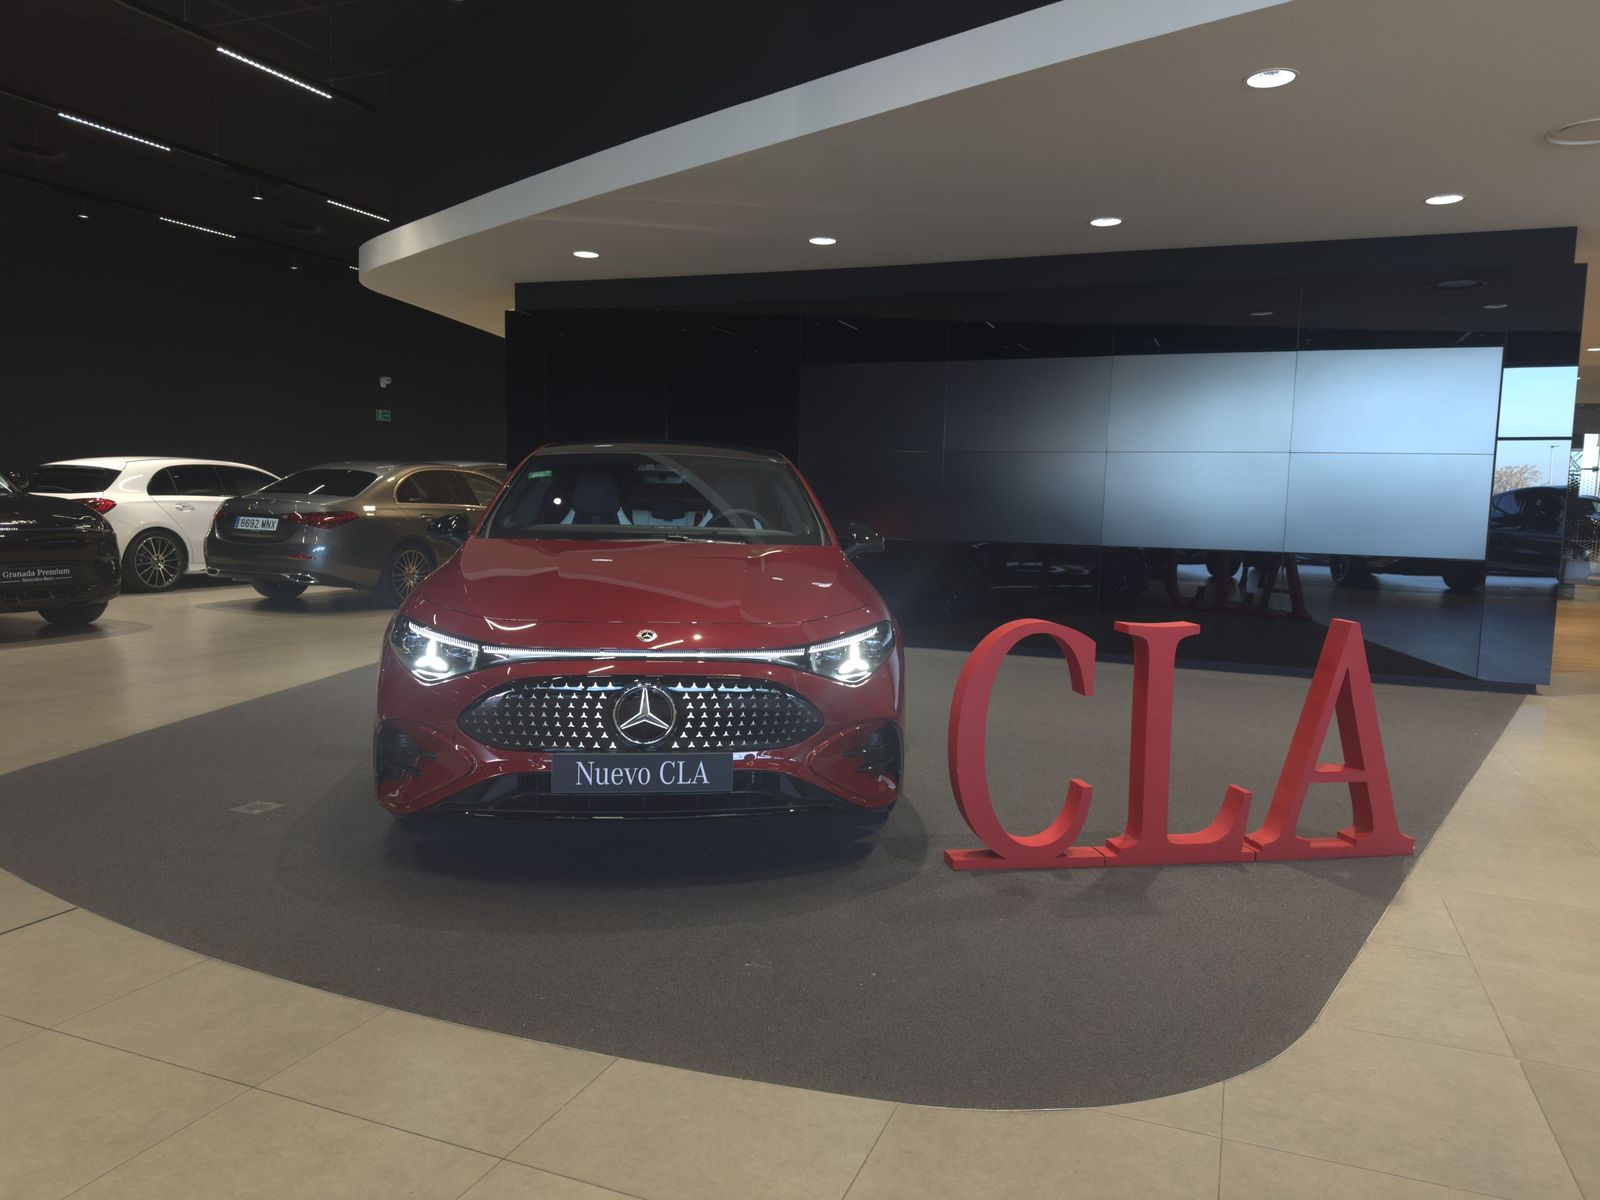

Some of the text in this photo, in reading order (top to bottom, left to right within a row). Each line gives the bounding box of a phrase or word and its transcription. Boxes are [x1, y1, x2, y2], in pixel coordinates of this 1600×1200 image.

[2, 568, 70, 579] Granada Premium
[944, 618, 1415, 870] CLA
[575, 761, 710, 785] Nuevo CLA
